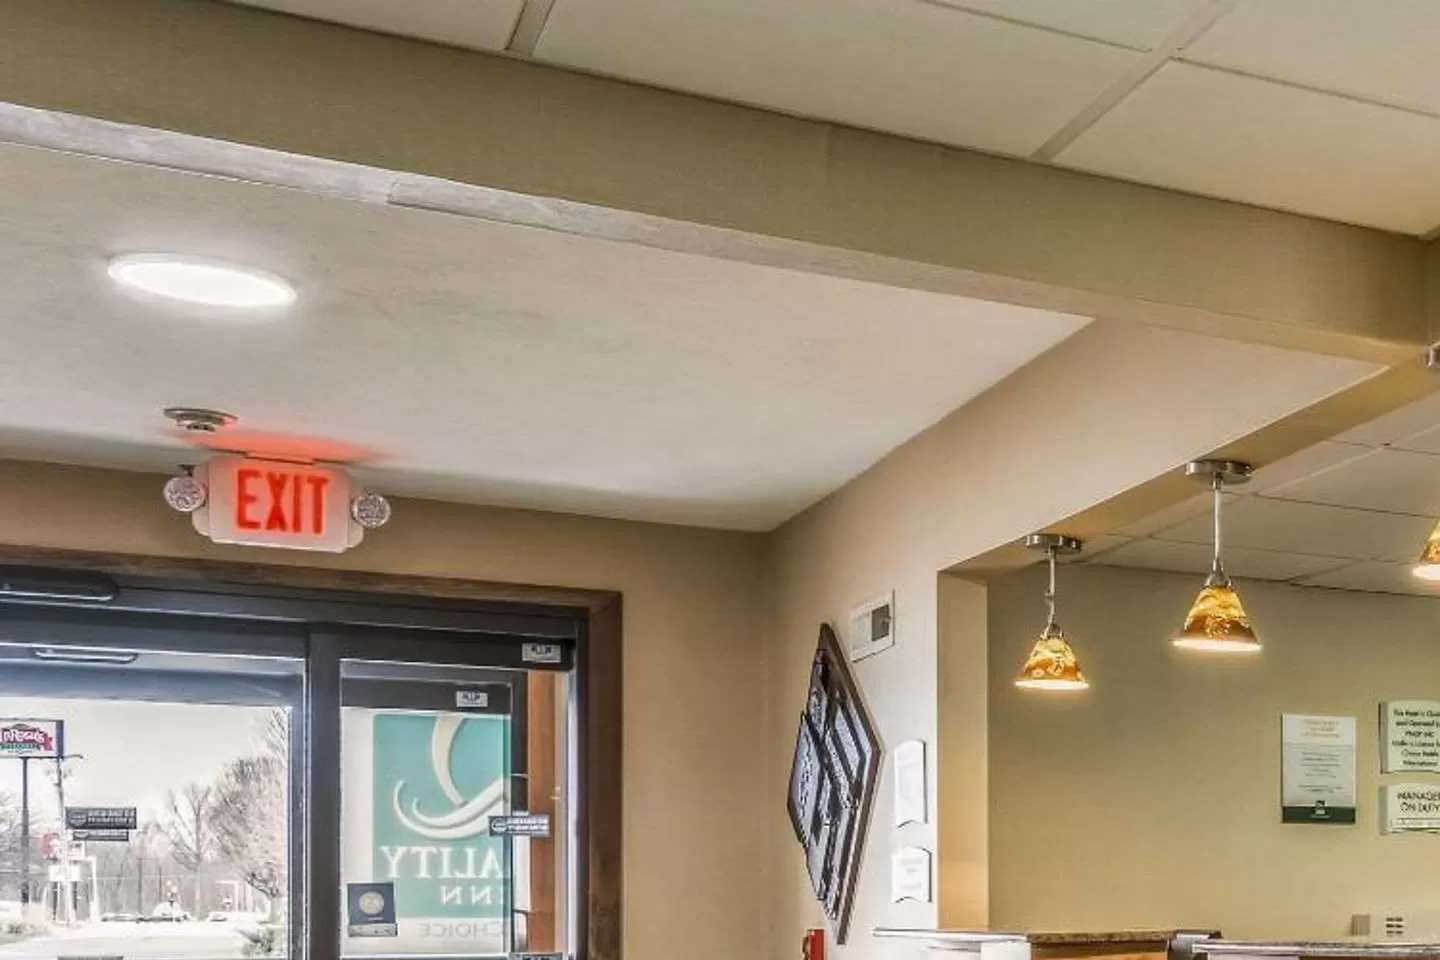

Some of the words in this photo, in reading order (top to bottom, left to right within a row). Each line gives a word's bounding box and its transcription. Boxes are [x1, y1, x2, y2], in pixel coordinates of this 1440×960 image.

[236, 468, 331, 535] EXIT
[1400, 801, 1416, 811] ON
[1417, 802, 1440, 813] DUTY
